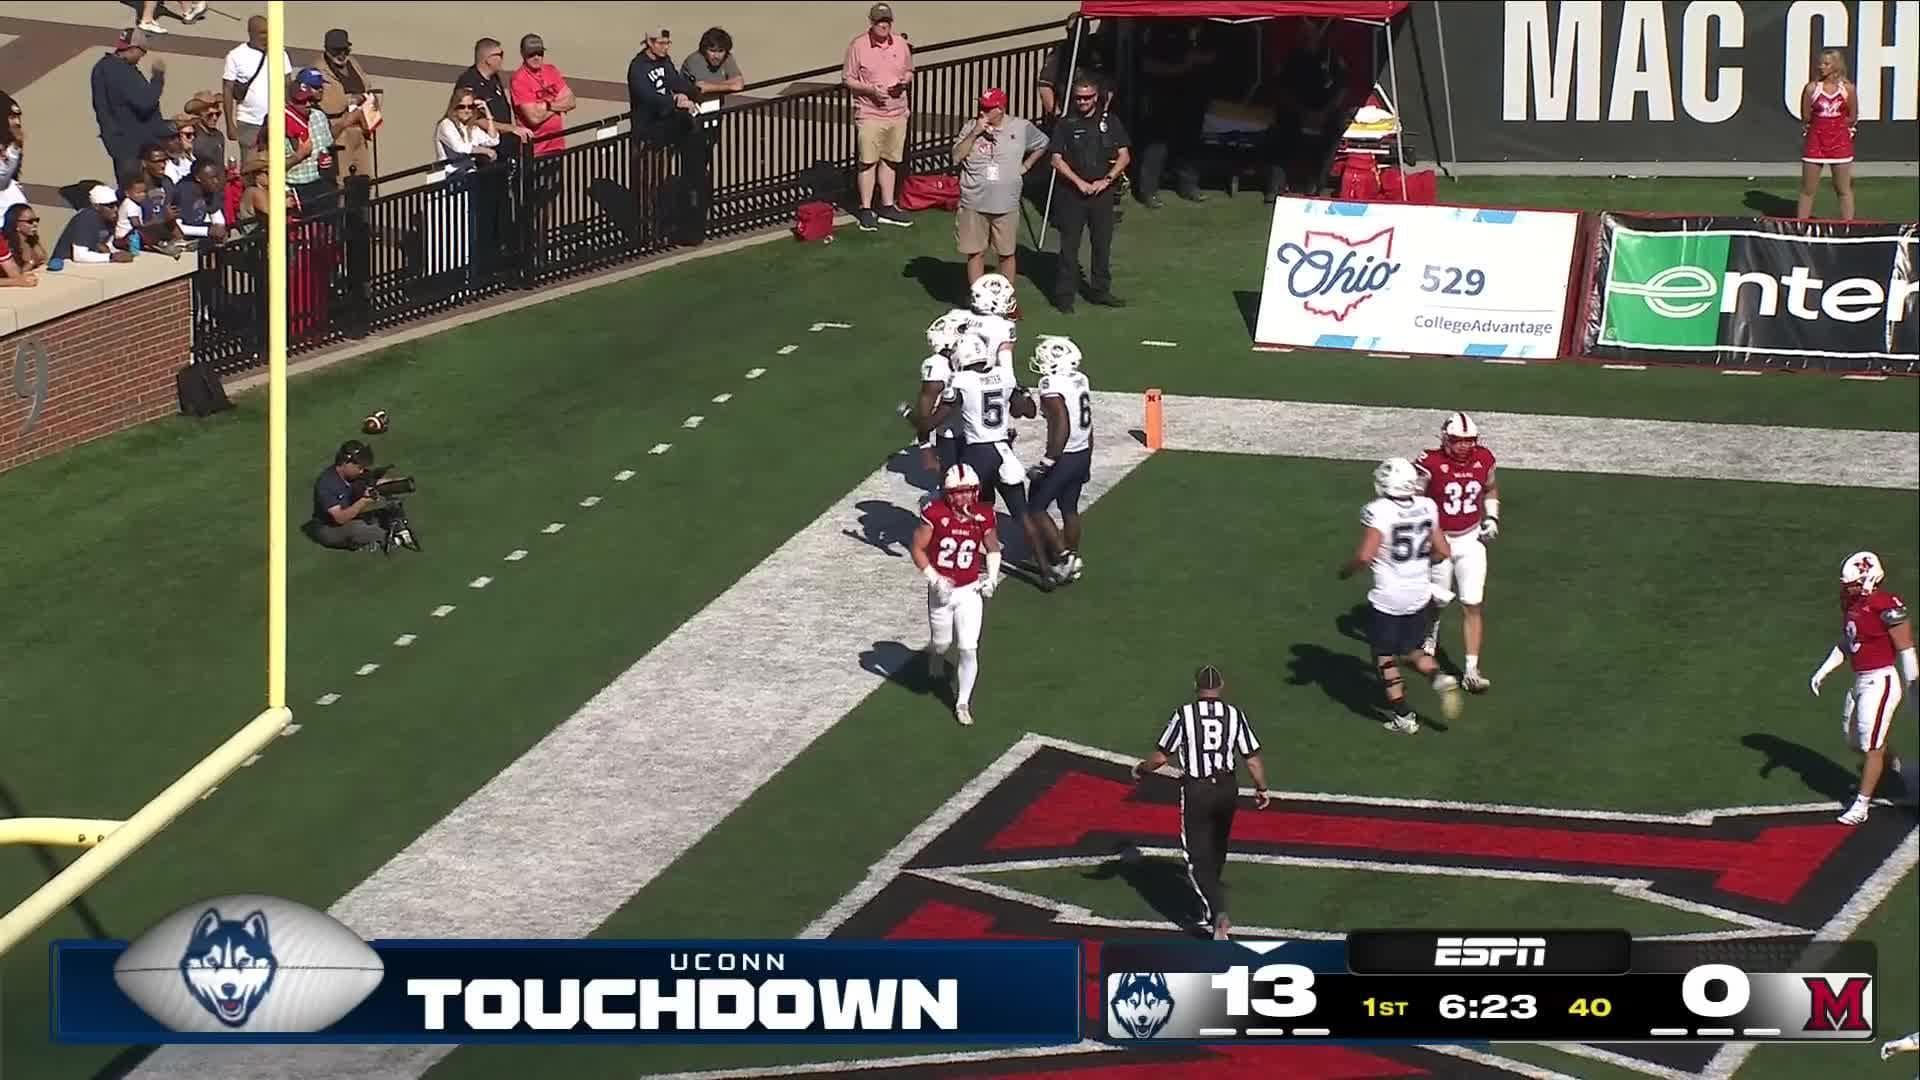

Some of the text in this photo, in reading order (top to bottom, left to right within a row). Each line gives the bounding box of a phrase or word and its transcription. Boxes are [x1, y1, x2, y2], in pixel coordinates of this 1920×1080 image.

[1503, 1, 1744, 123] MAC
[1277, 242, 1401, 298] Ohio
[1420, 264, 1486, 297] 529
[1610, 265, 1919, 323] enter
[1413, 314, 1553, 337] CollegeAdvantage
[981, 388, 1004, 430] 5
[1443, 480, 1482, 516] 32
[937, 537, 977, 569] 26
[1391, 518, 1433, 562] 52
[1201, 719, 1223, 750] B
